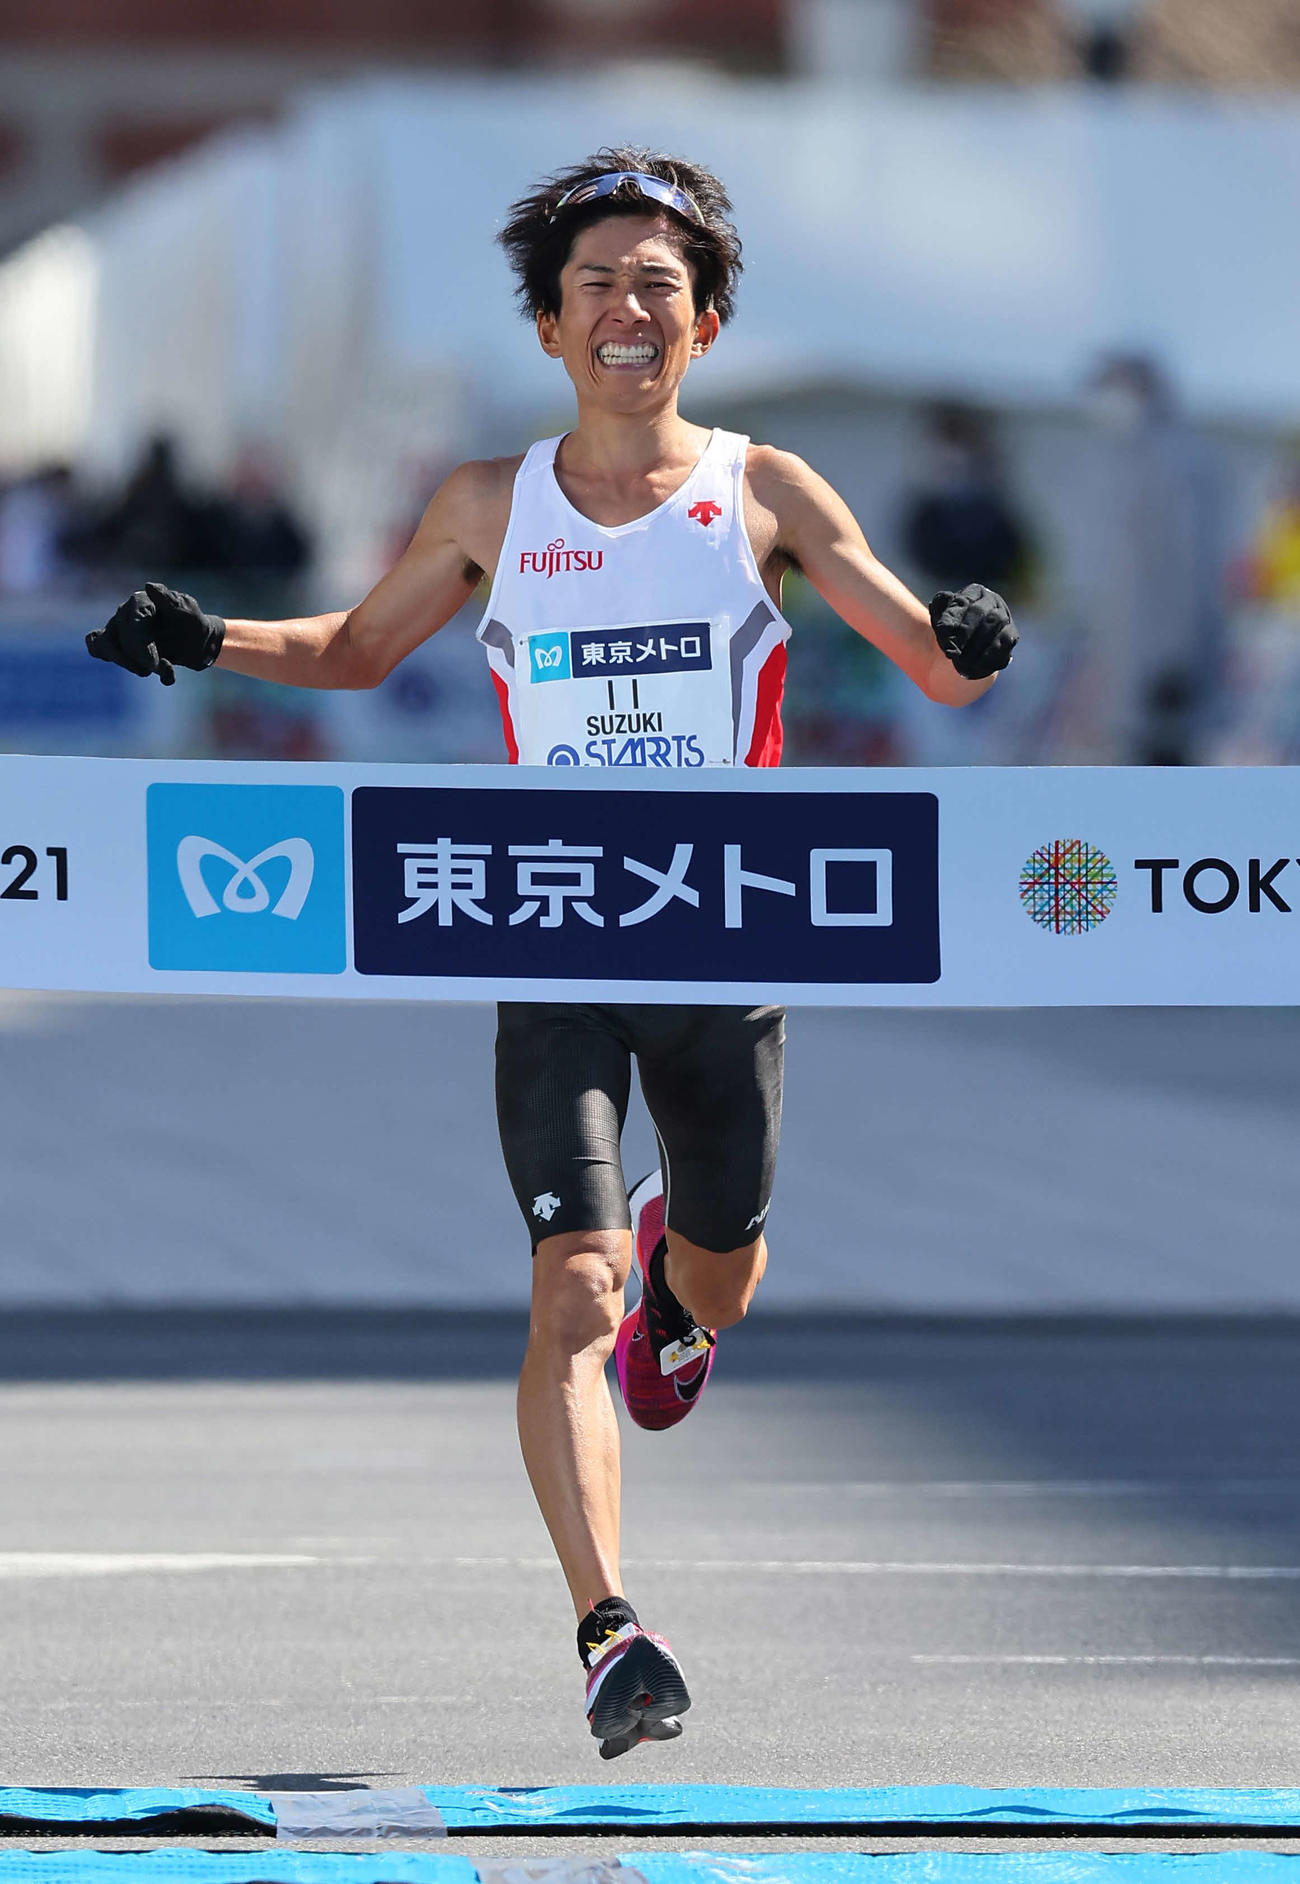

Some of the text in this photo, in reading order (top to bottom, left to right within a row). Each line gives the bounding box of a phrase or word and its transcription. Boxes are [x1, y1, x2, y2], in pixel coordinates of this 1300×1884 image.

[519, 538, 603, 580] FUJITSU
[581, 636, 701, 666] 東京メトロ
[607, 678, 639, 711] 11
[586, 711, 663, 737] SUZUKI
[396, 836, 894, 930] 東京メトロ
[1134, 857, 1300, 914] TOK
